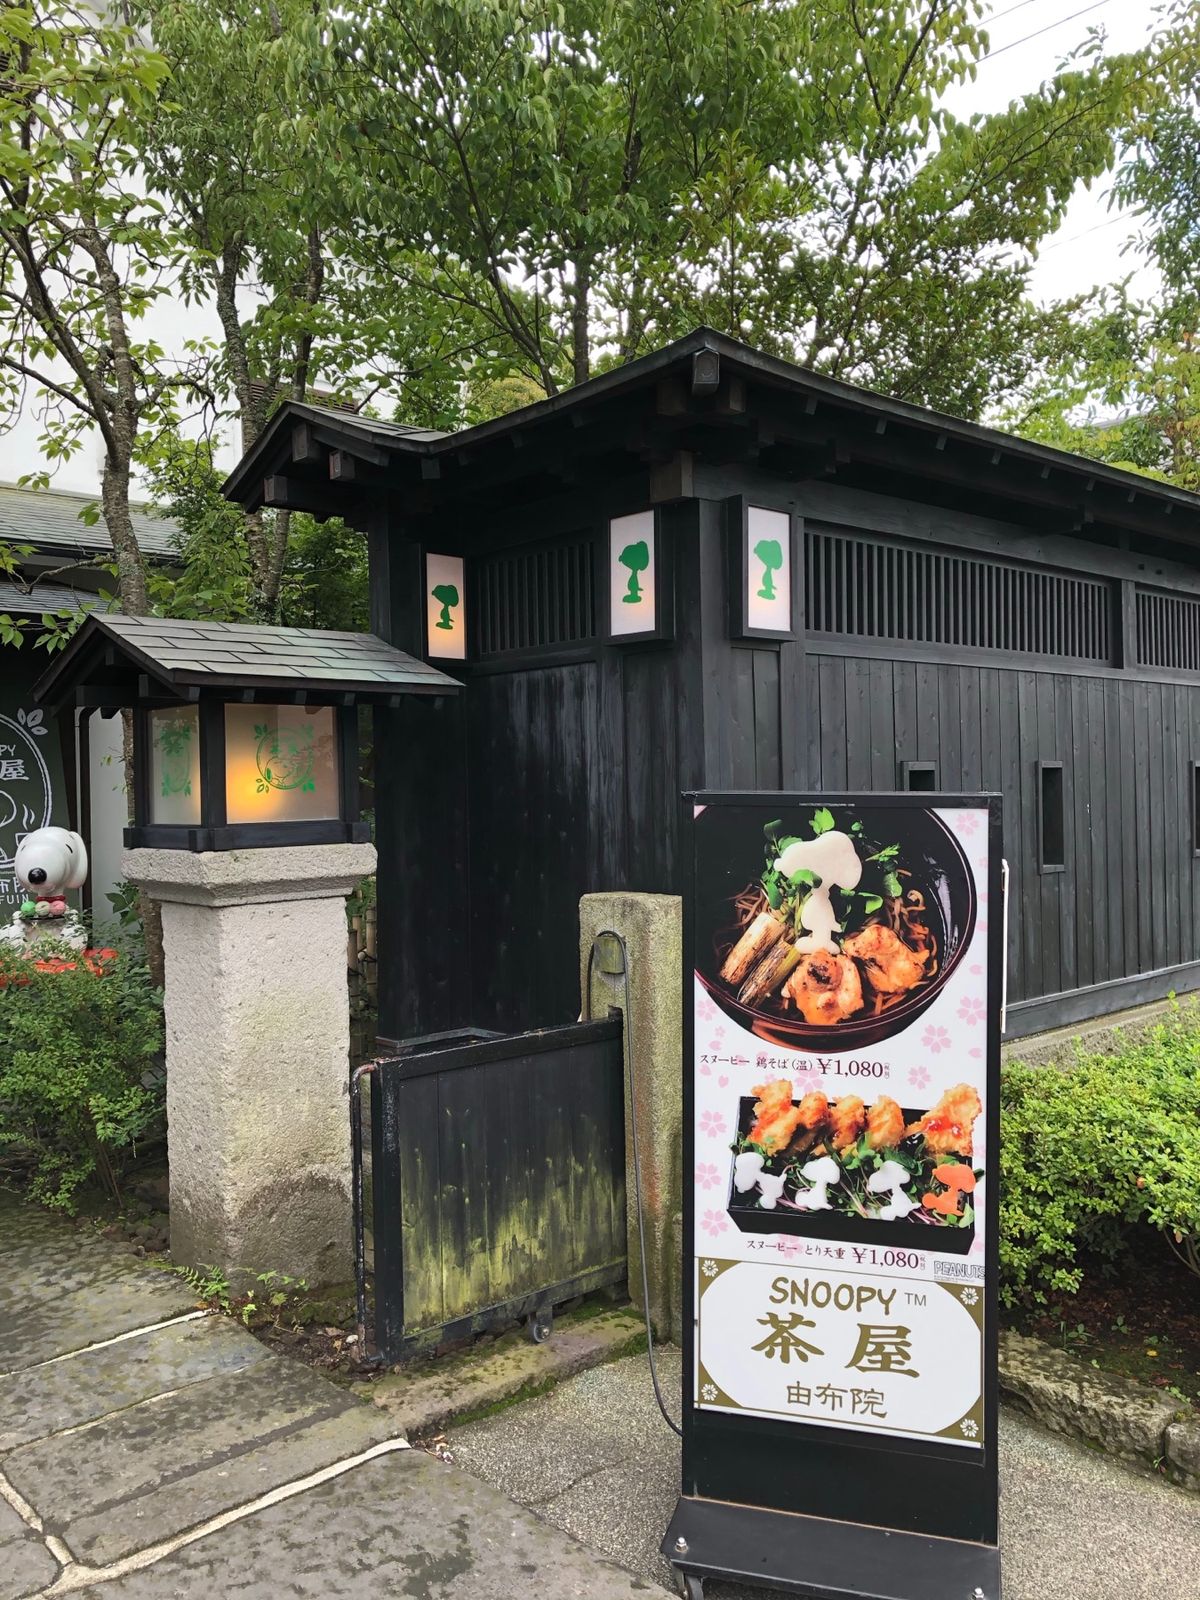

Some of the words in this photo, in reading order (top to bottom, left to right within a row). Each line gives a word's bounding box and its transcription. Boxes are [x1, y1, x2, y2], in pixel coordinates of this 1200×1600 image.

[817, 1058, 884, 1077] ¥1,080
[805, 1245, 845, 1259] とり天重
[851, 1247, 919, 1269] ¥1,080
[933, 1260, 986, 1280] PEANUTS
[769, 1277, 896, 1315] SNOOPY
[904, 1291, 927, 1307] TM
[786, 1380, 888, 1419] 由布院
